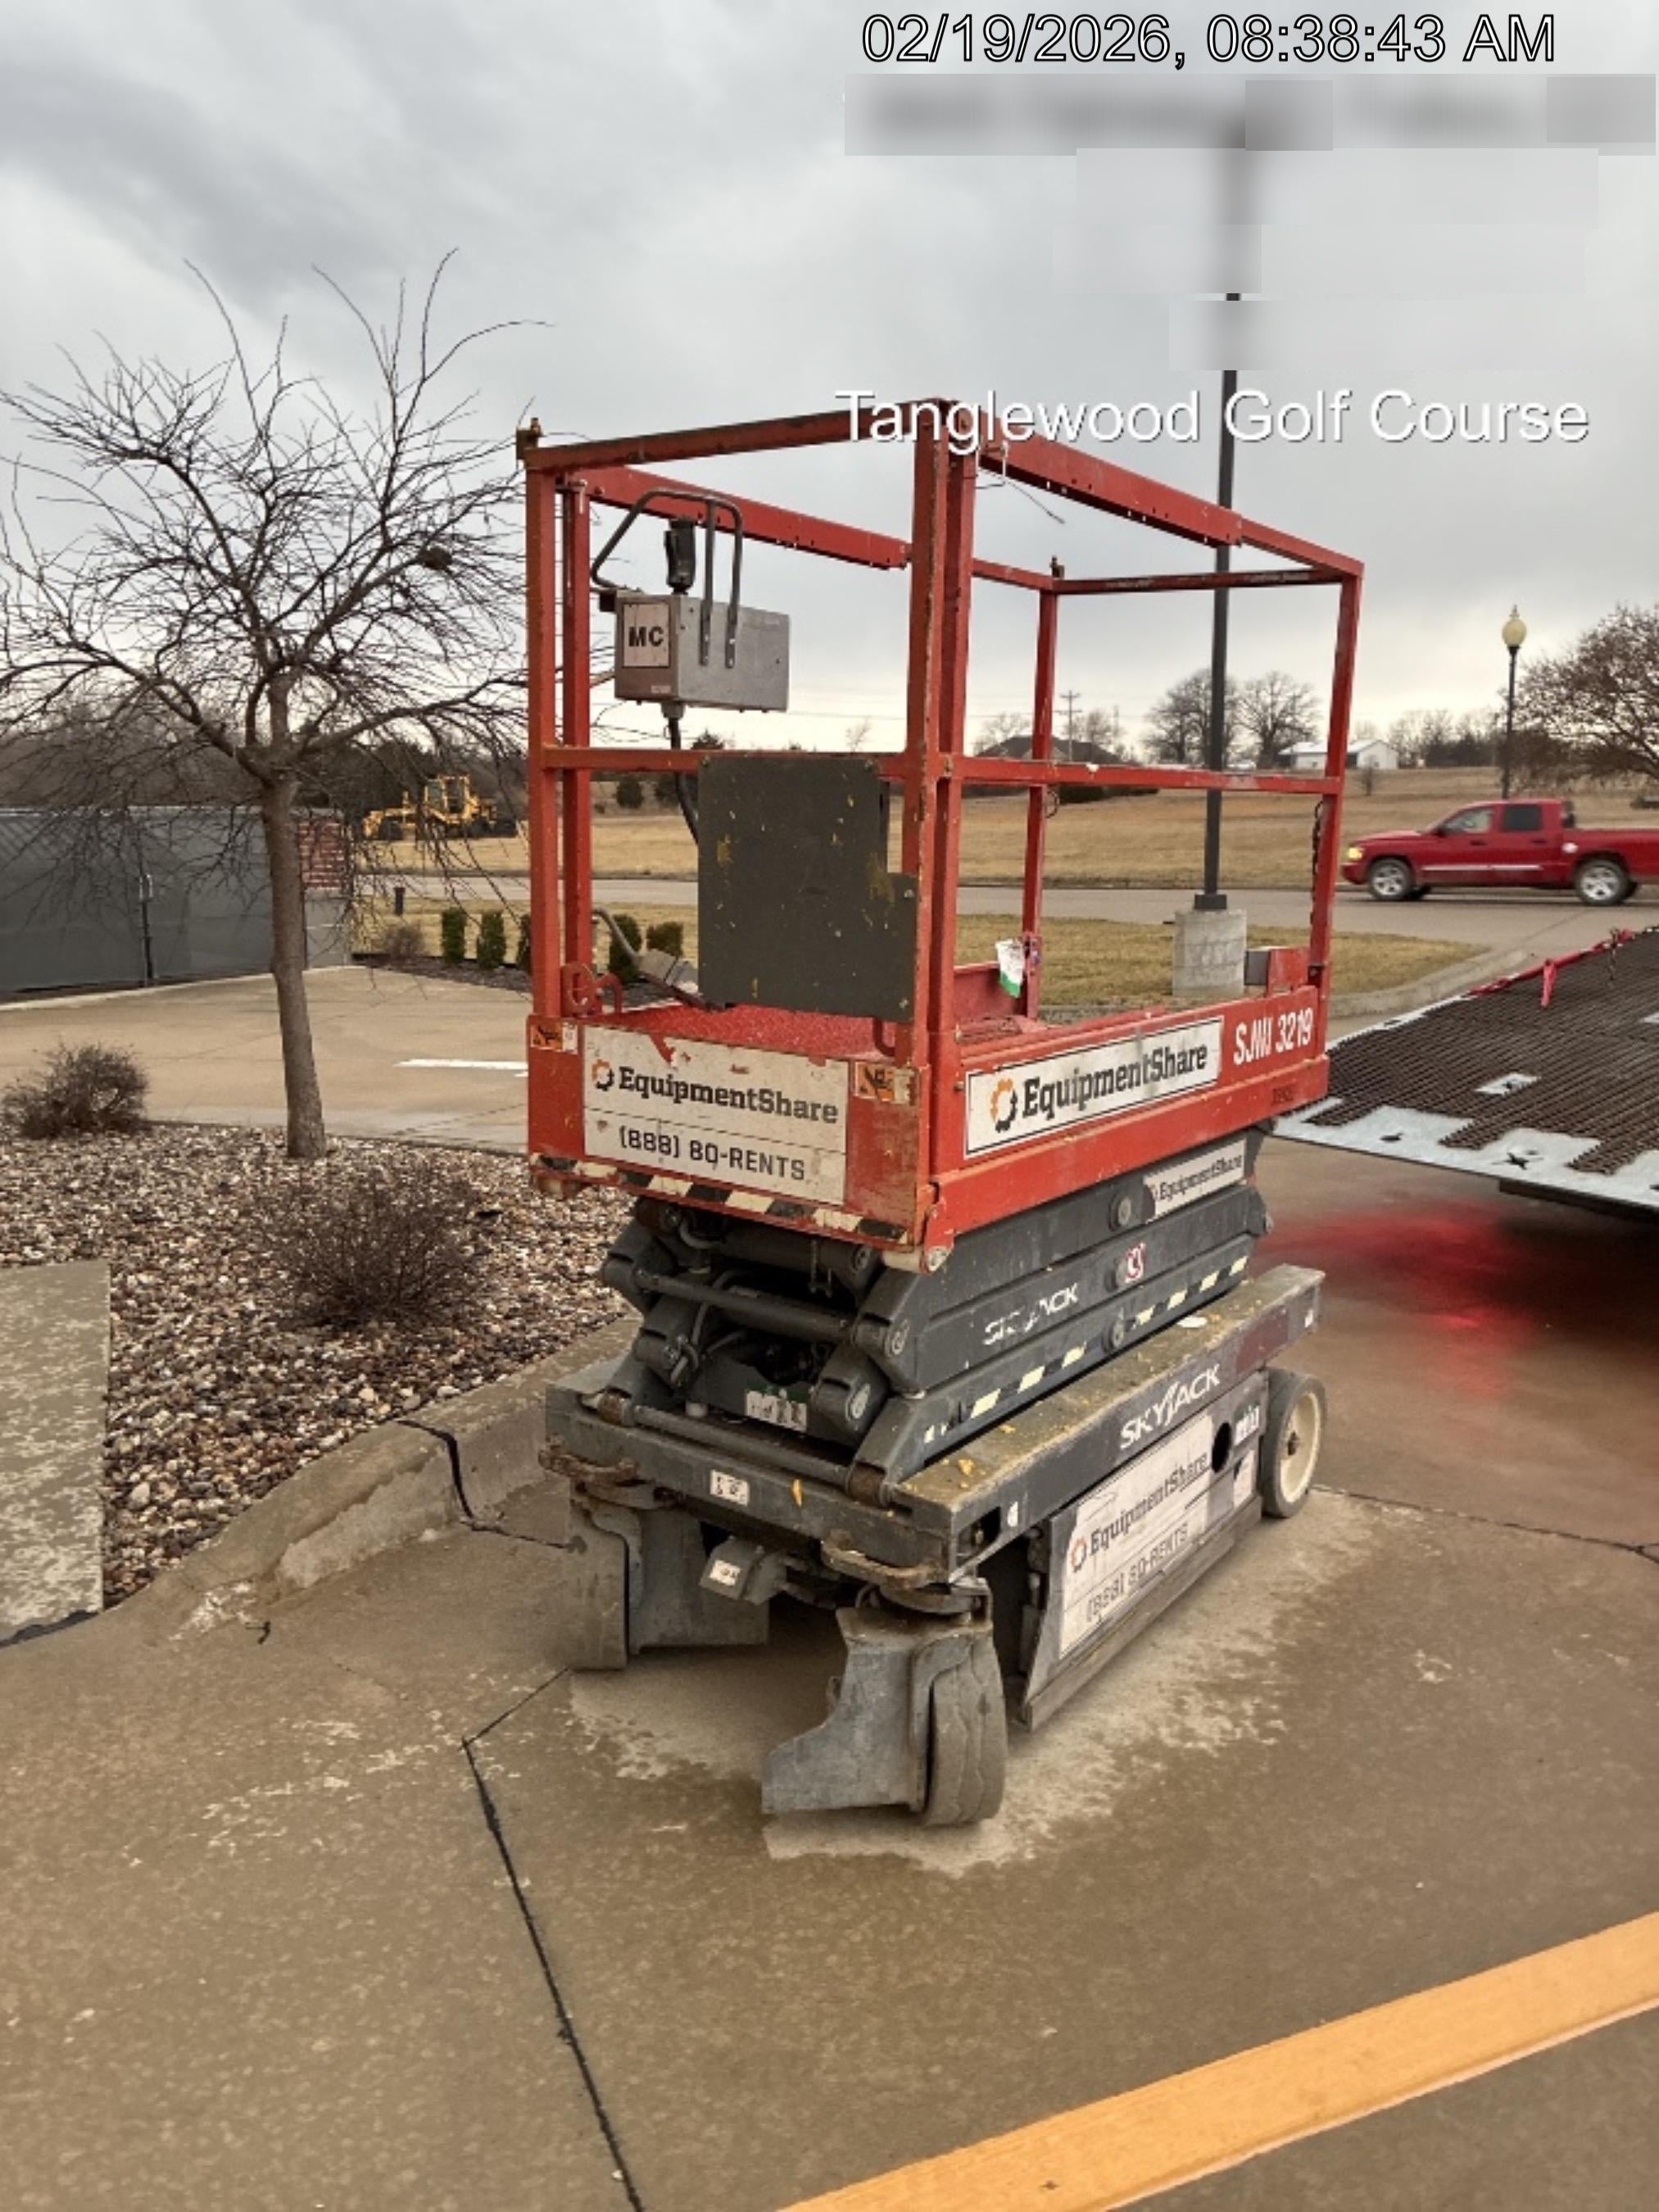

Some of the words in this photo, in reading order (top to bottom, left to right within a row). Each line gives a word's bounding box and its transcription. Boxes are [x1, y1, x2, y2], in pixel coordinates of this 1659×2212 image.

[628, 626, 664, 647] MC
[1275, 1006, 1313, 1054] 3219
[619, 1065, 839, 1124] EquipmentShare
[1022, 1042, 1208, 1119] EquipmentShare
[619, 1125, 680, 1158] (888)
[1159, 1154, 1243, 1203] EquipmentShare
[1120, 1362, 1221, 1450] SKYJACK
